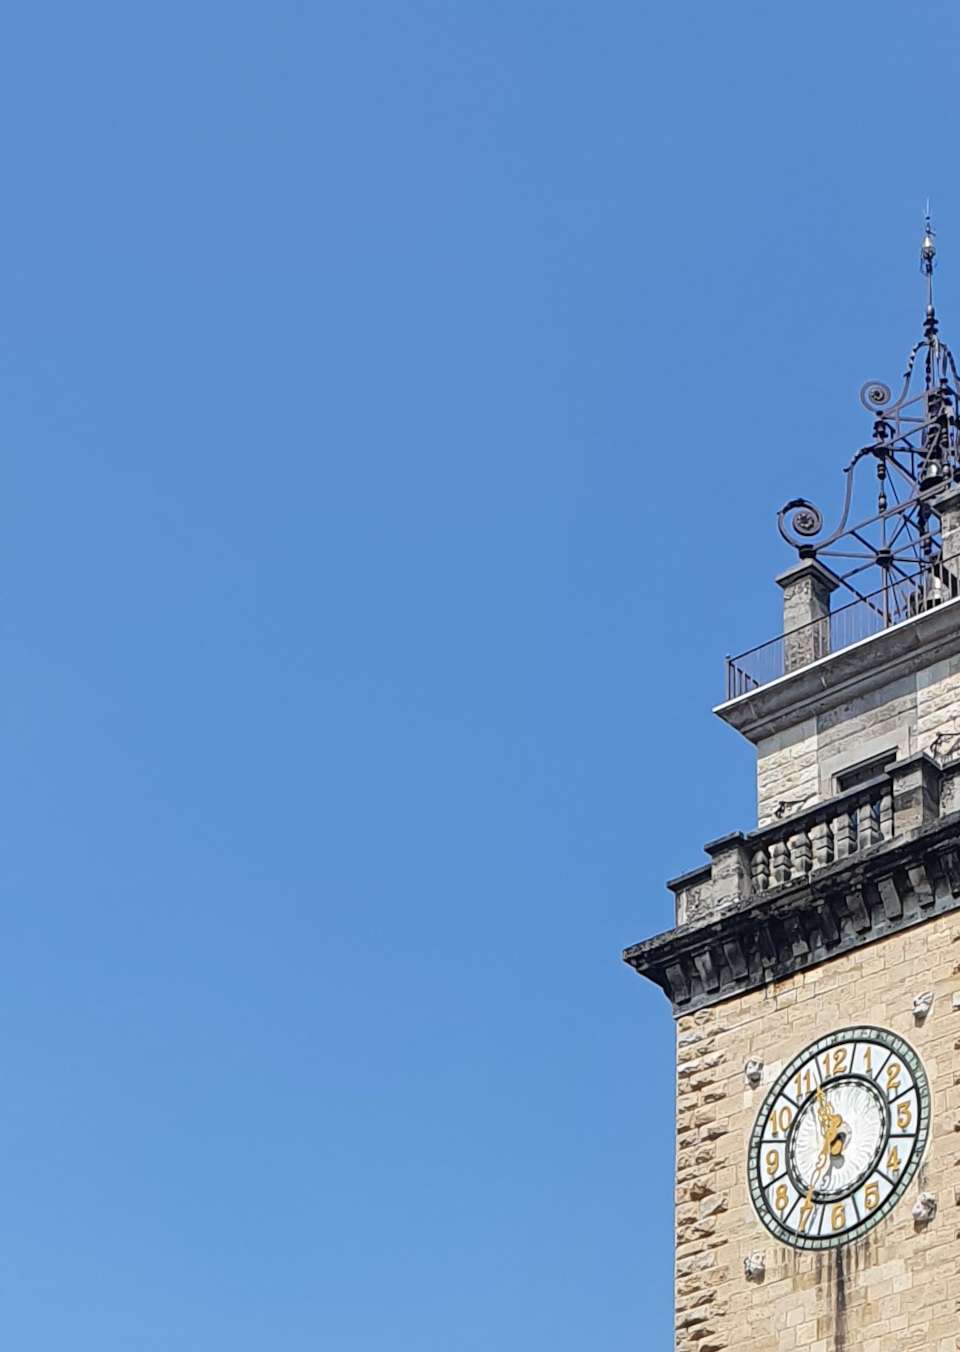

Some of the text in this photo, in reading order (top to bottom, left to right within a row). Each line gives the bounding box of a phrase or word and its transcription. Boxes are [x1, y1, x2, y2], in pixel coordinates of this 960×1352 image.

[822, 1048, 848, 1079] 12
[863, 1046, 872, 1074] 1
[794, 1068, 812, 1097] 11
[886, 1063, 900, 1089] 2
[769, 1106, 792, 1136] 10
[896, 1101, 911, 1129] 3
[766, 1149, 779, 1176] 9
[887, 1145, 901, 1170] 4
[775, 1183, 789, 1211] 8
[864, 1181, 880, 1210] 5
[831, 1204, 845, 1231] 6
